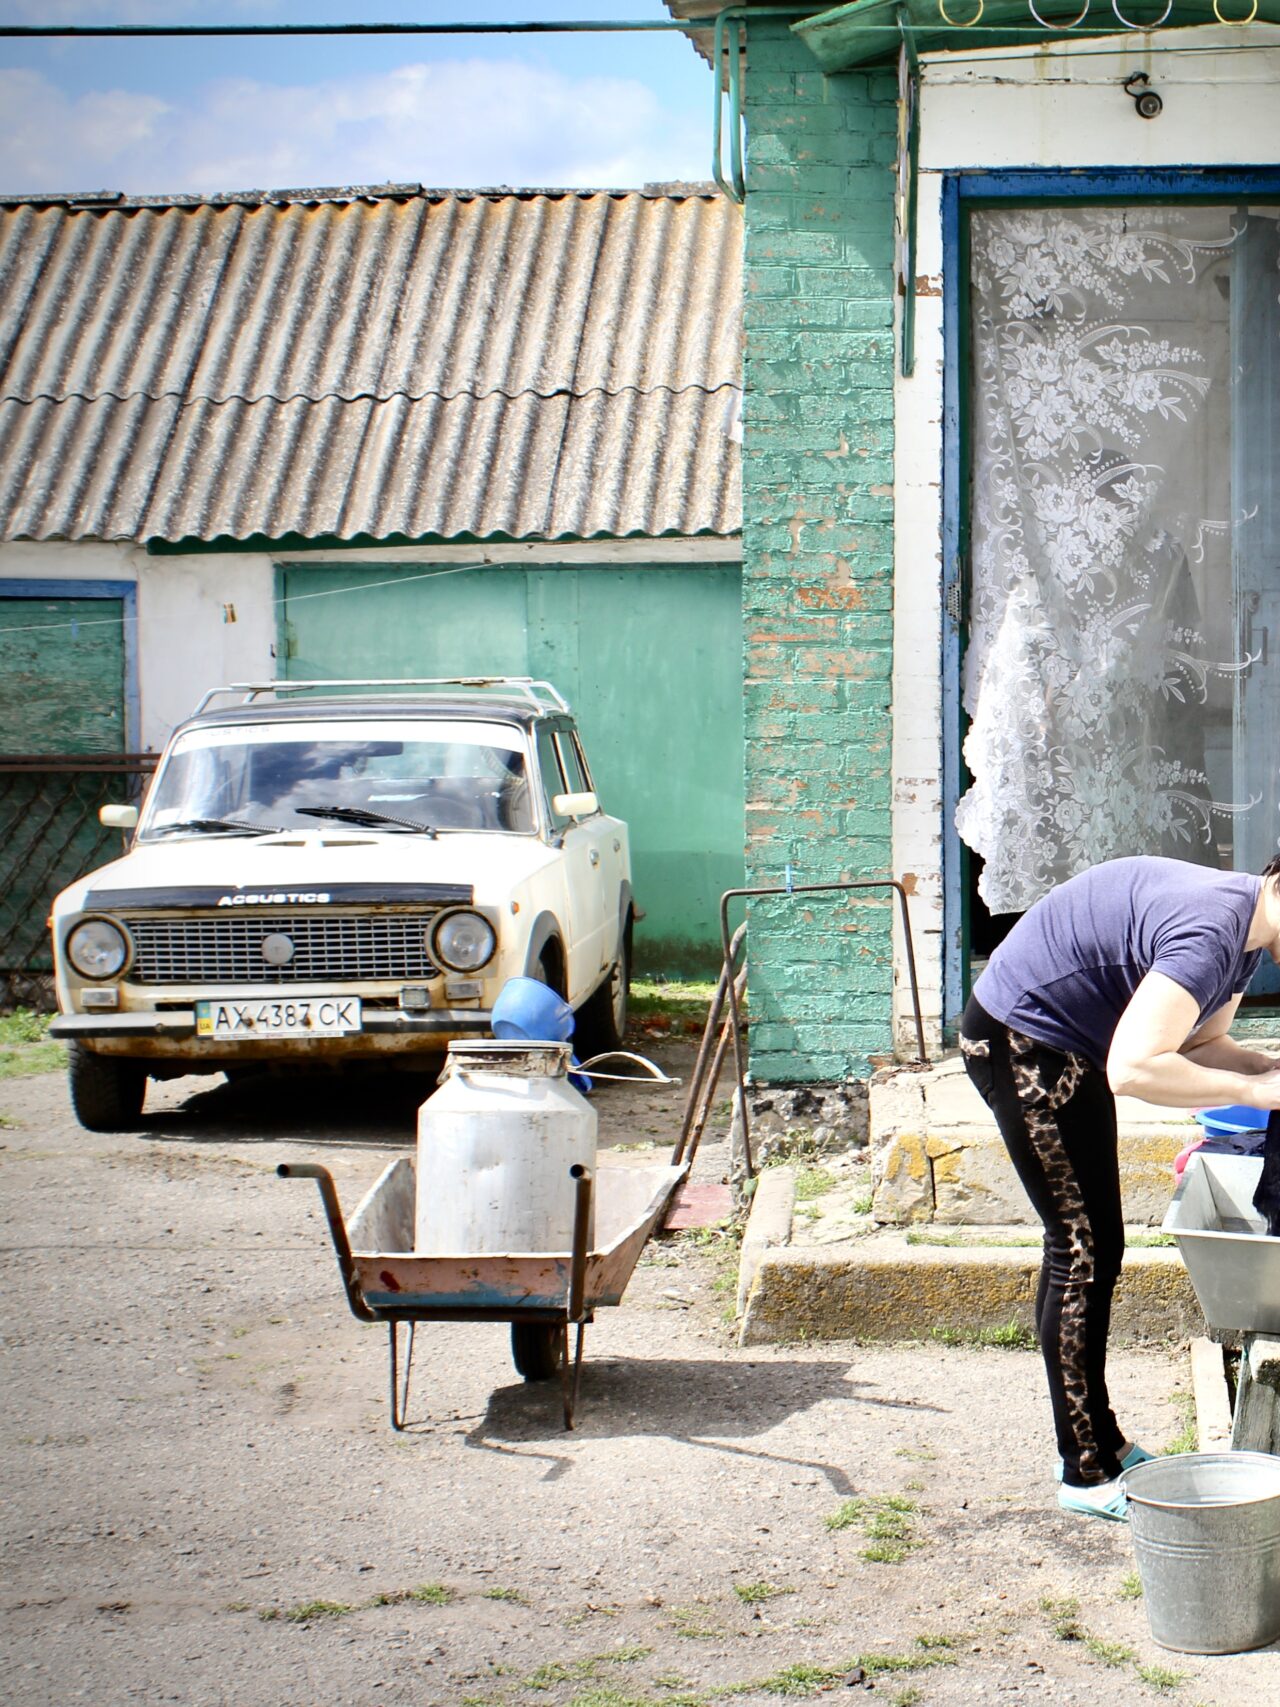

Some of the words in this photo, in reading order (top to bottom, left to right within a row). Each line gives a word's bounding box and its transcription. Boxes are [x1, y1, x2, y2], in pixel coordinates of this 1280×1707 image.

[217, 893, 331, 906] ACOUSTICS
[216, 1006, 249, 1029] AX
[257, 1003, 312, 1027] 4387
[319, 1001, 353, 1026] CK
[200, 1022, 211, 1030] UA
